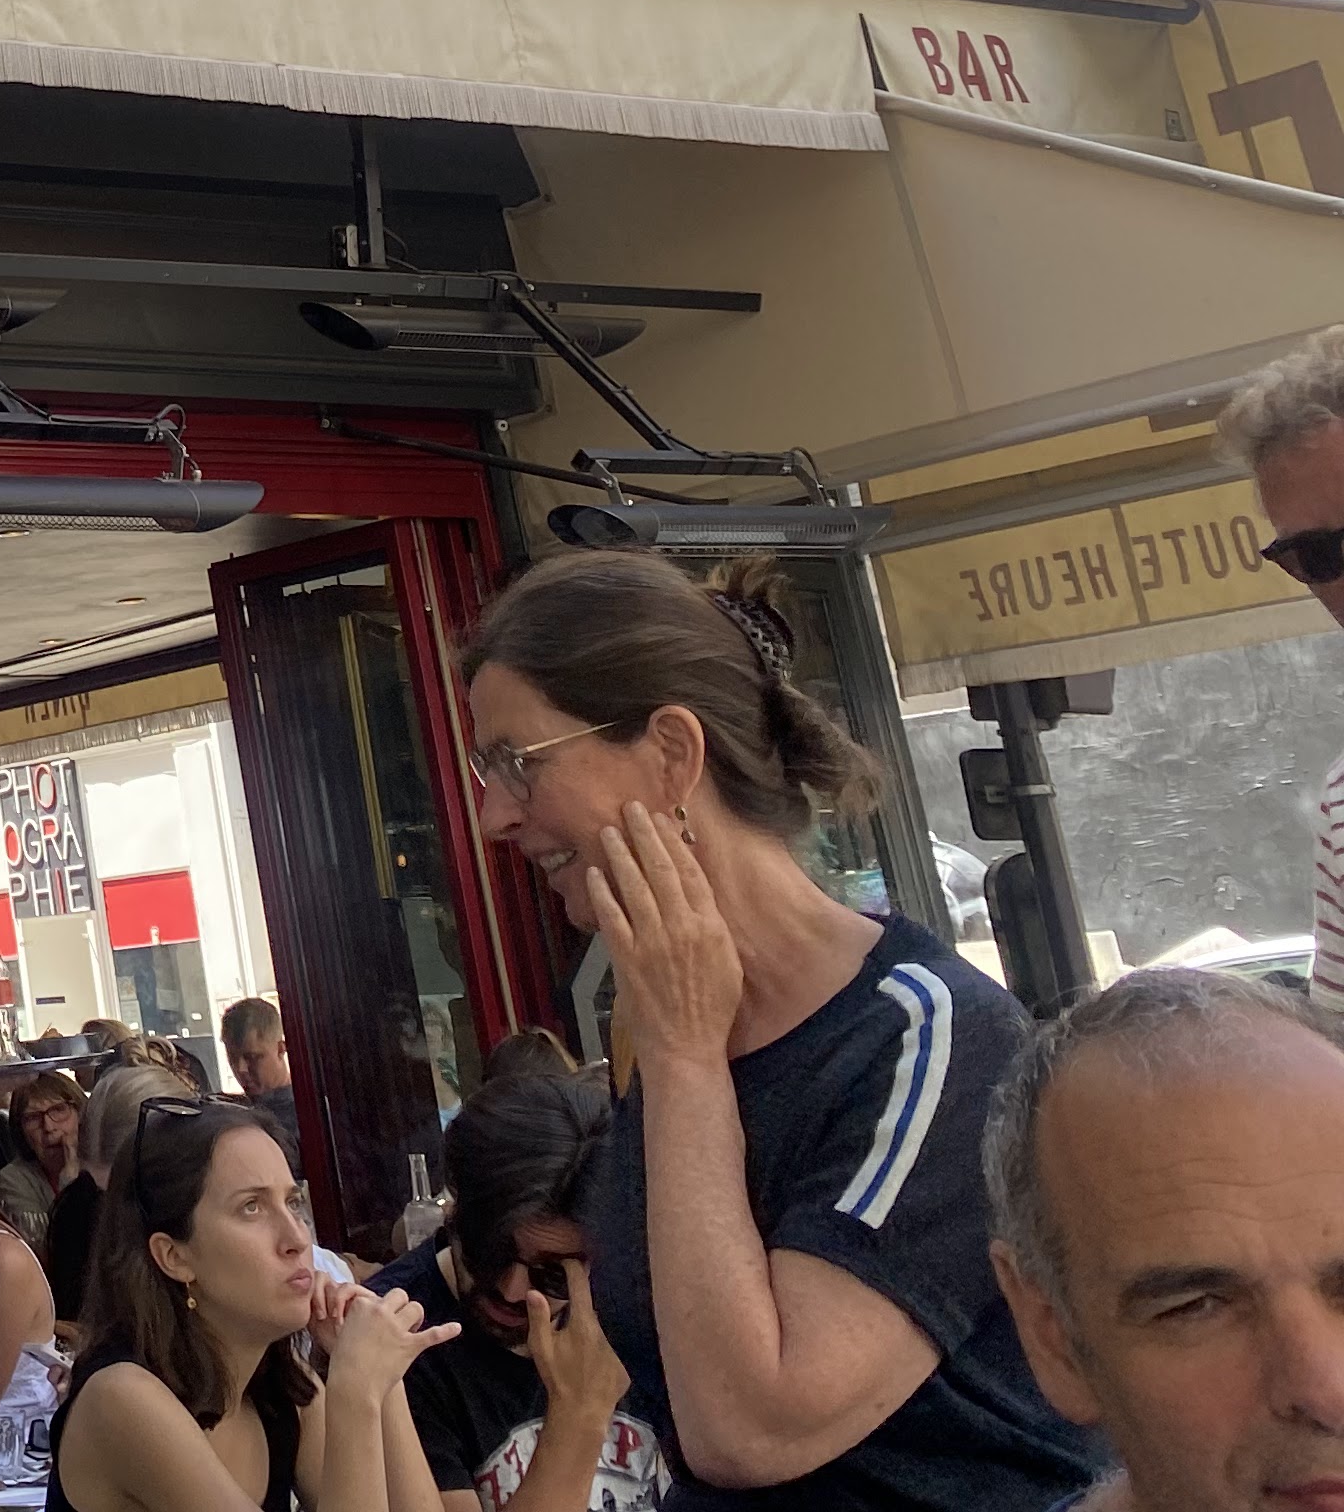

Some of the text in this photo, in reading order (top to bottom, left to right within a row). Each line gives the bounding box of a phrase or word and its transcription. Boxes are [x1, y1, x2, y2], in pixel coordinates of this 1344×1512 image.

[912, 26, 1030, 104] BAR
[3, 813, 83, 868] OGRA
[8, 863, 91, 917] PHIE
